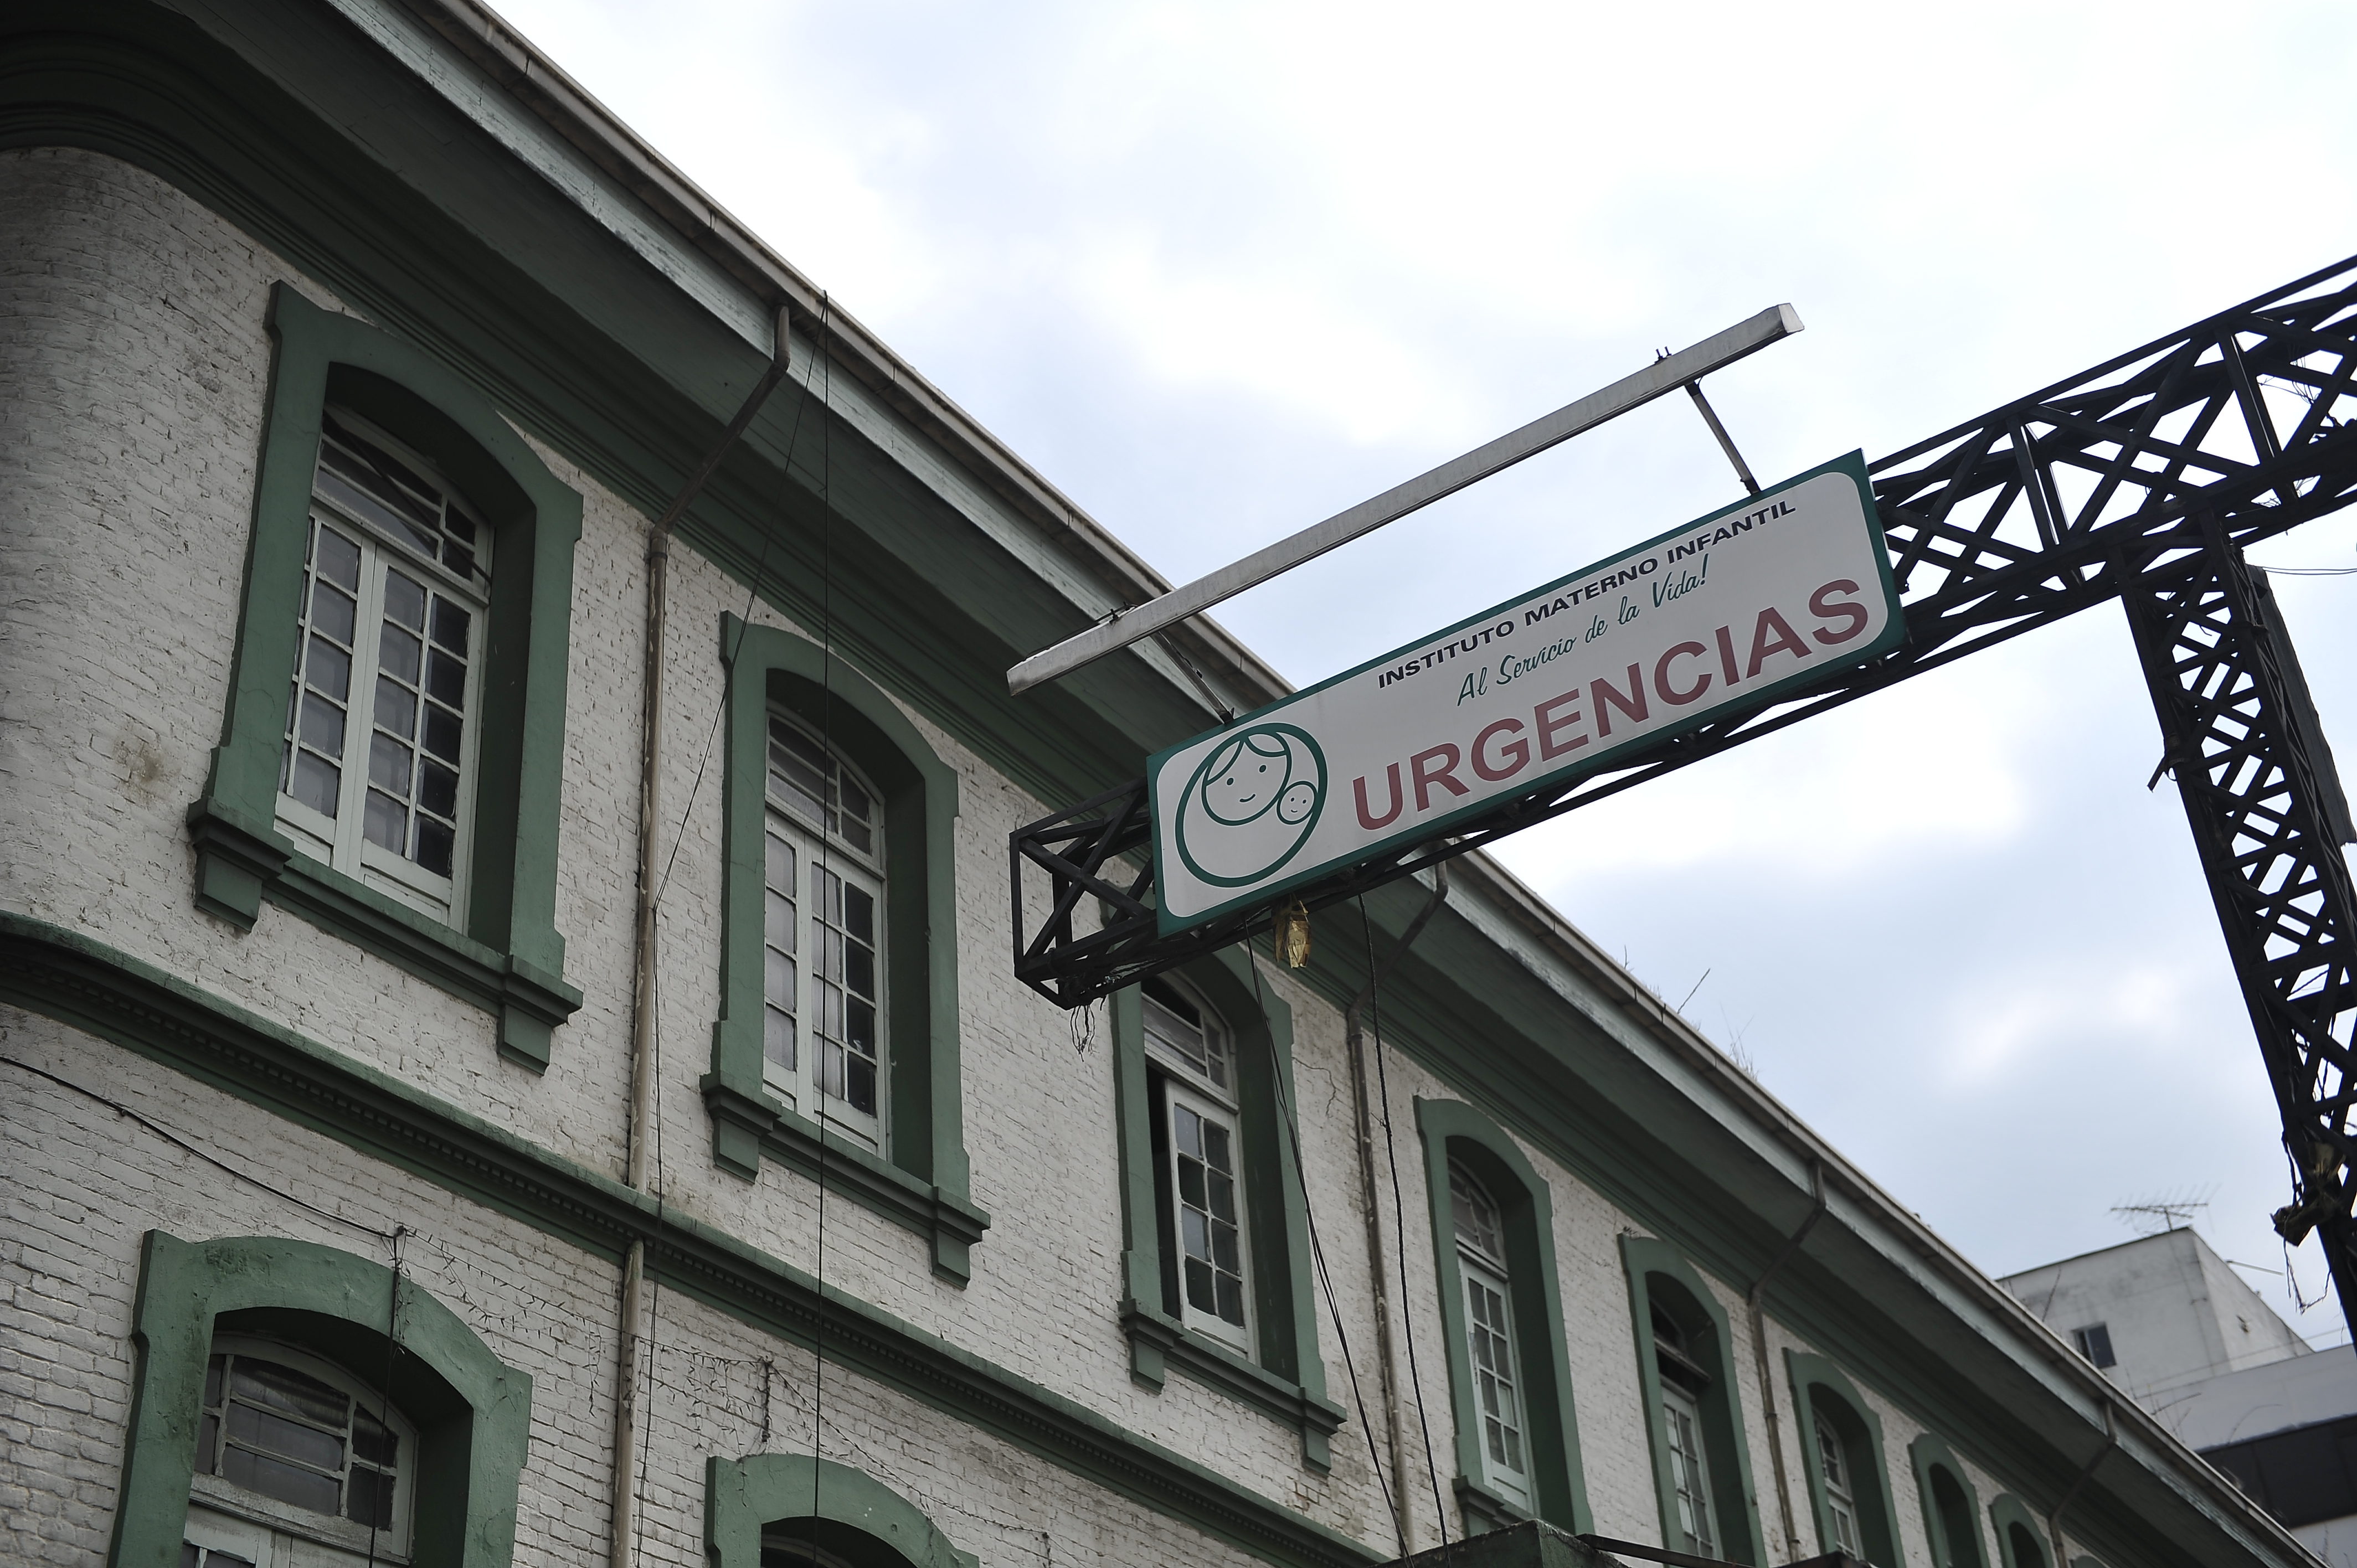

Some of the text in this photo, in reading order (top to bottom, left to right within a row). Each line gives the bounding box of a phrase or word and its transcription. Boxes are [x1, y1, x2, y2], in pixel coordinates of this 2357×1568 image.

[1378, 500, 1797, 689] INSTITUTO MATERNO INFANTIL
[1457, 552, 1710, 708] Al Servicio de la Vida!
[1352, 578, 1869, 831] URGENCIAS
